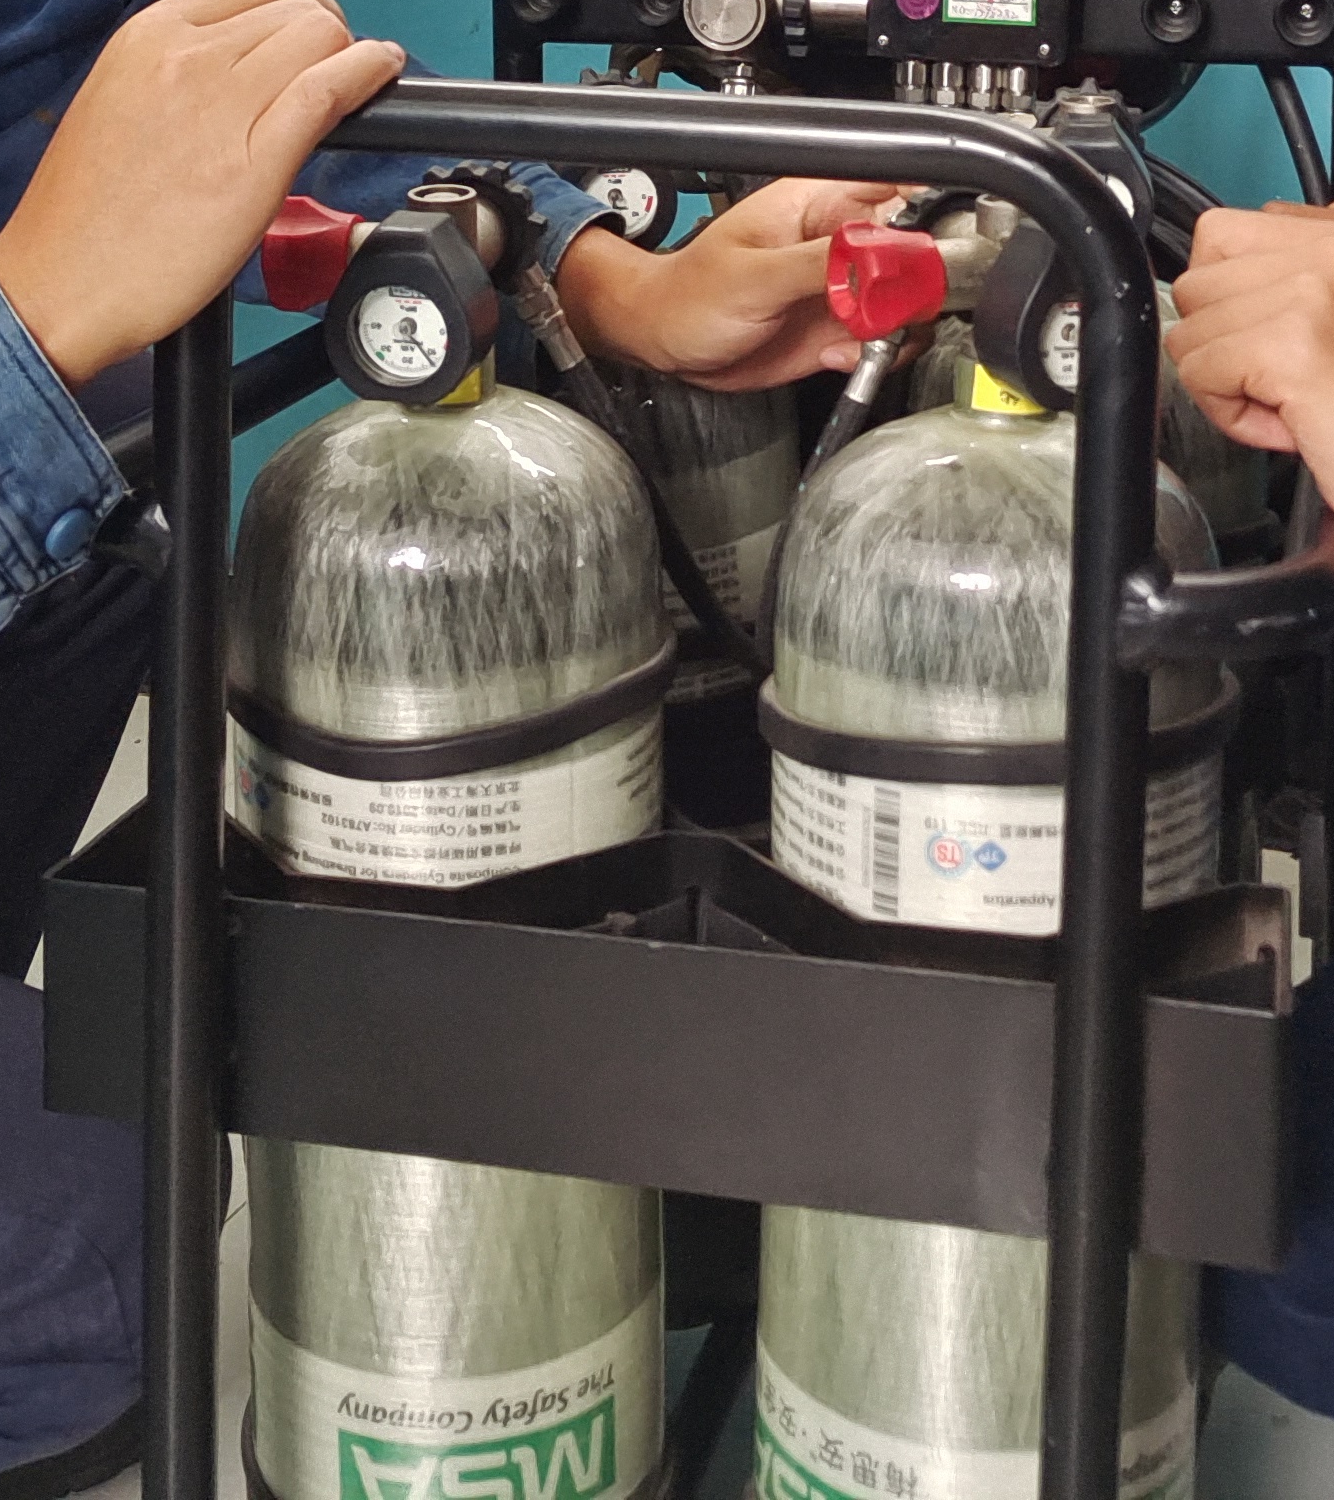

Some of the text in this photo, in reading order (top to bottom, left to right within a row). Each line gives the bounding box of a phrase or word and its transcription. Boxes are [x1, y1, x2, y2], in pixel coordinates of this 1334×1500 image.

[380, 780, 521, 800] 北京天海工业有限公司
[360, 869, 378, 879] for
[982, 891, 1056, 908] Apparatus
[336, 1363, 615, 1434] The Safety Company
[350, 1411, 605, 1500] MSA
